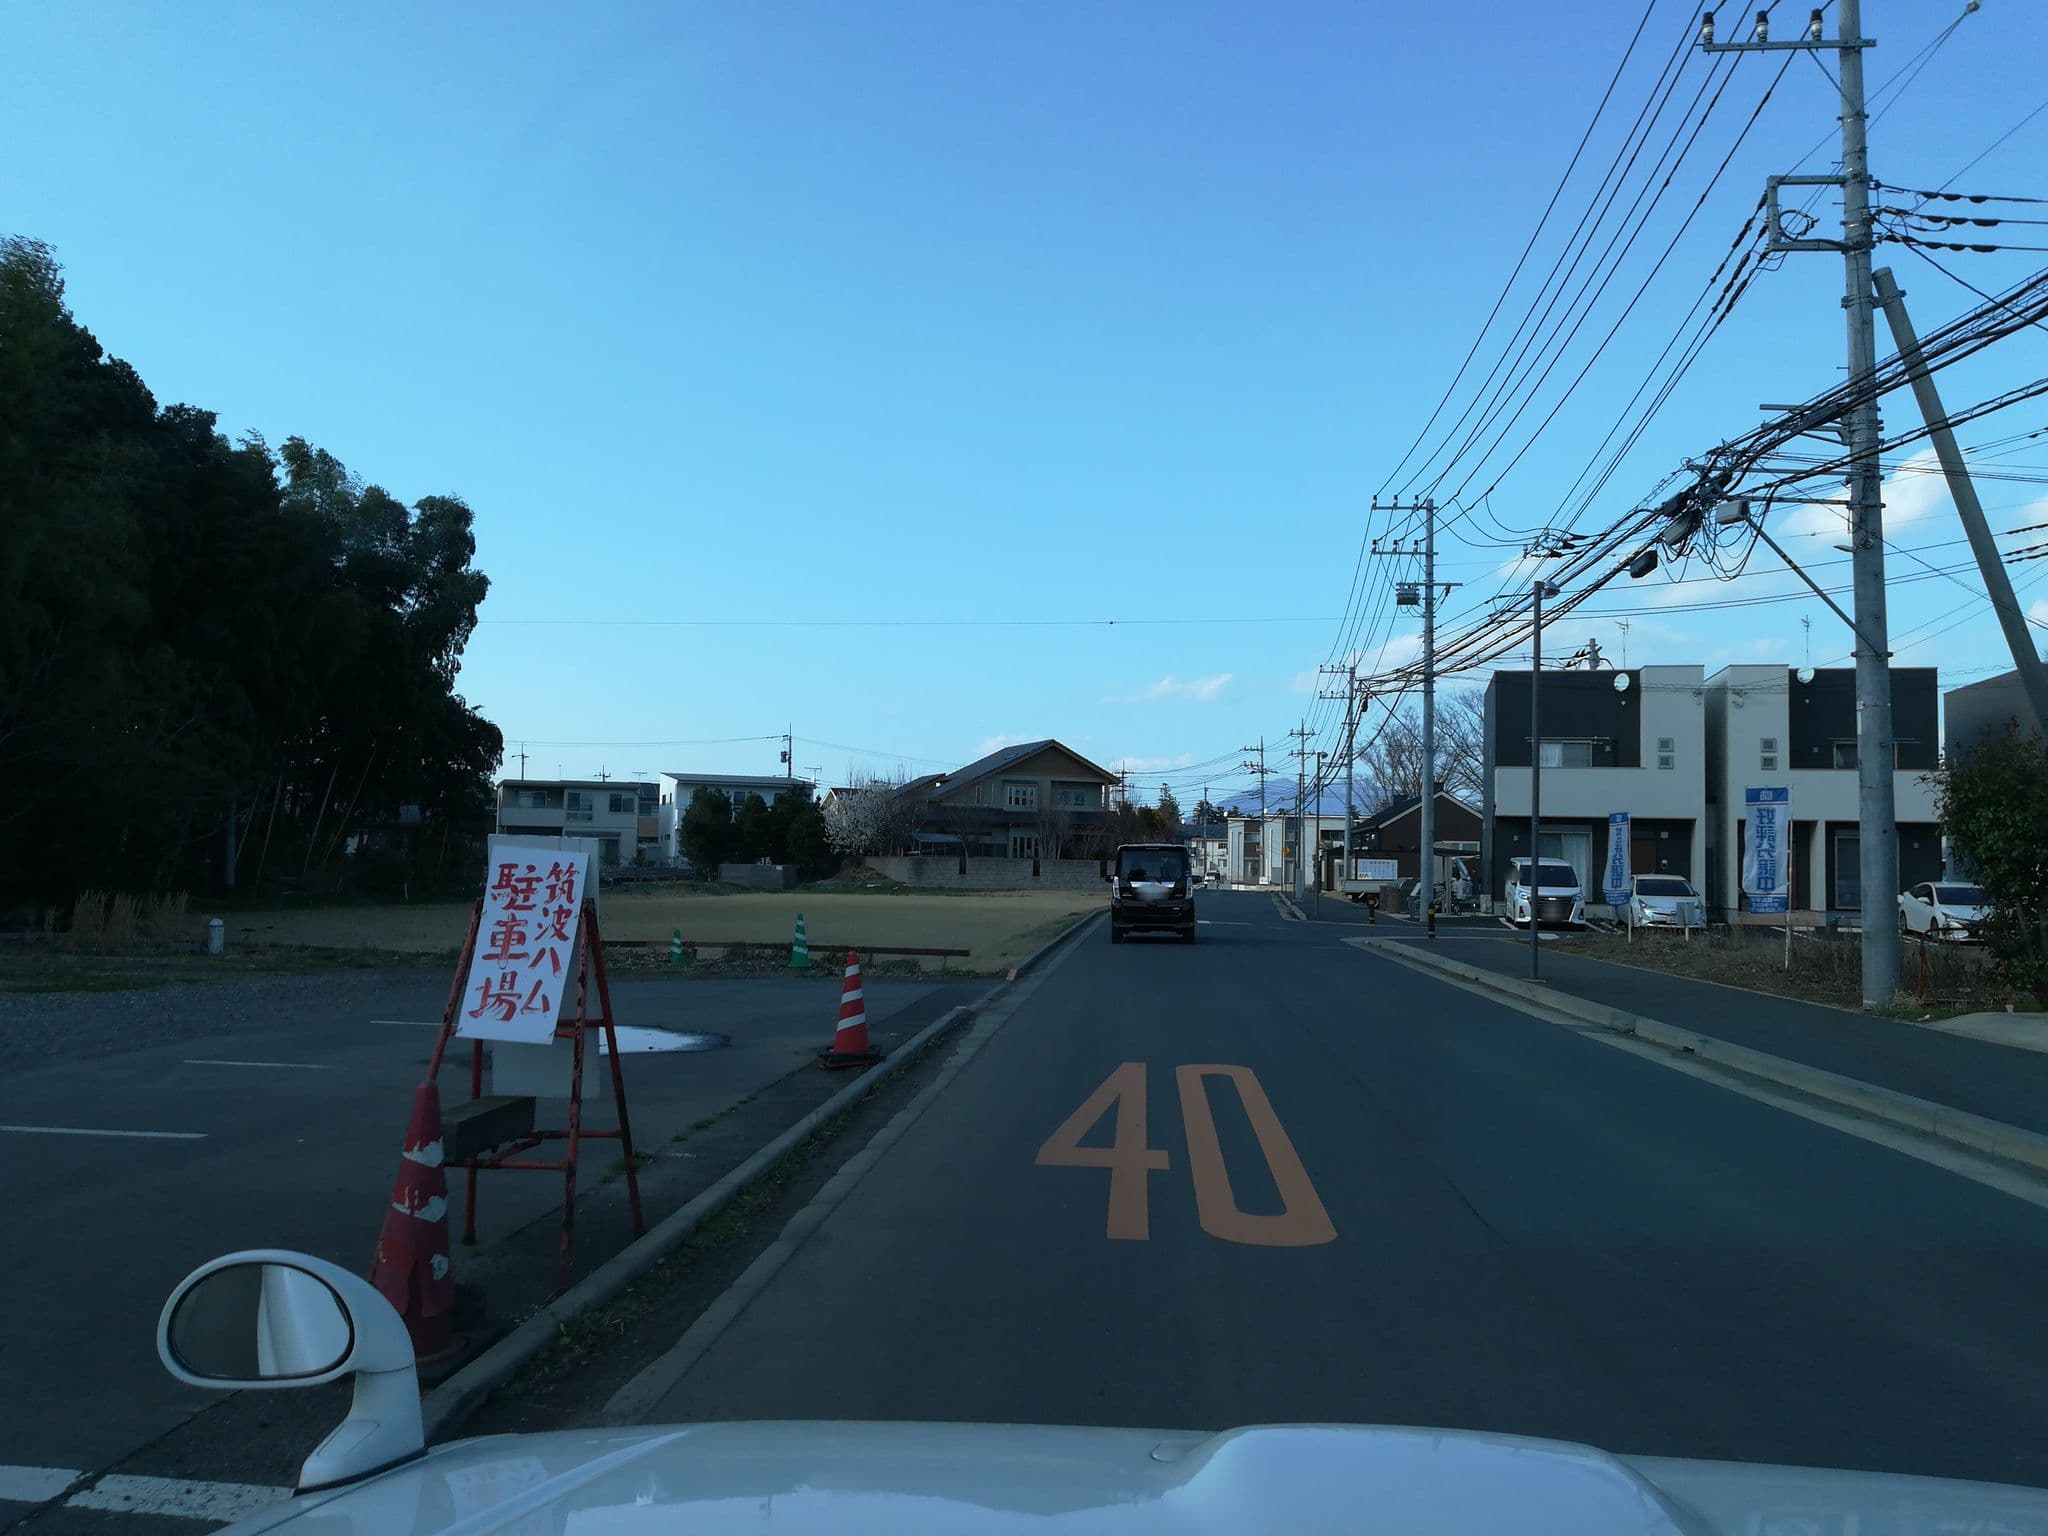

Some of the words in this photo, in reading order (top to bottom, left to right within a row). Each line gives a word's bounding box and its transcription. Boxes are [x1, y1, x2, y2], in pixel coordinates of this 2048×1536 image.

[469, 863, 544, 1022] 駐車場
[521, 861, 580, 1014] 筑波ハム
[1035, 1061, 1339, 1248] 40
